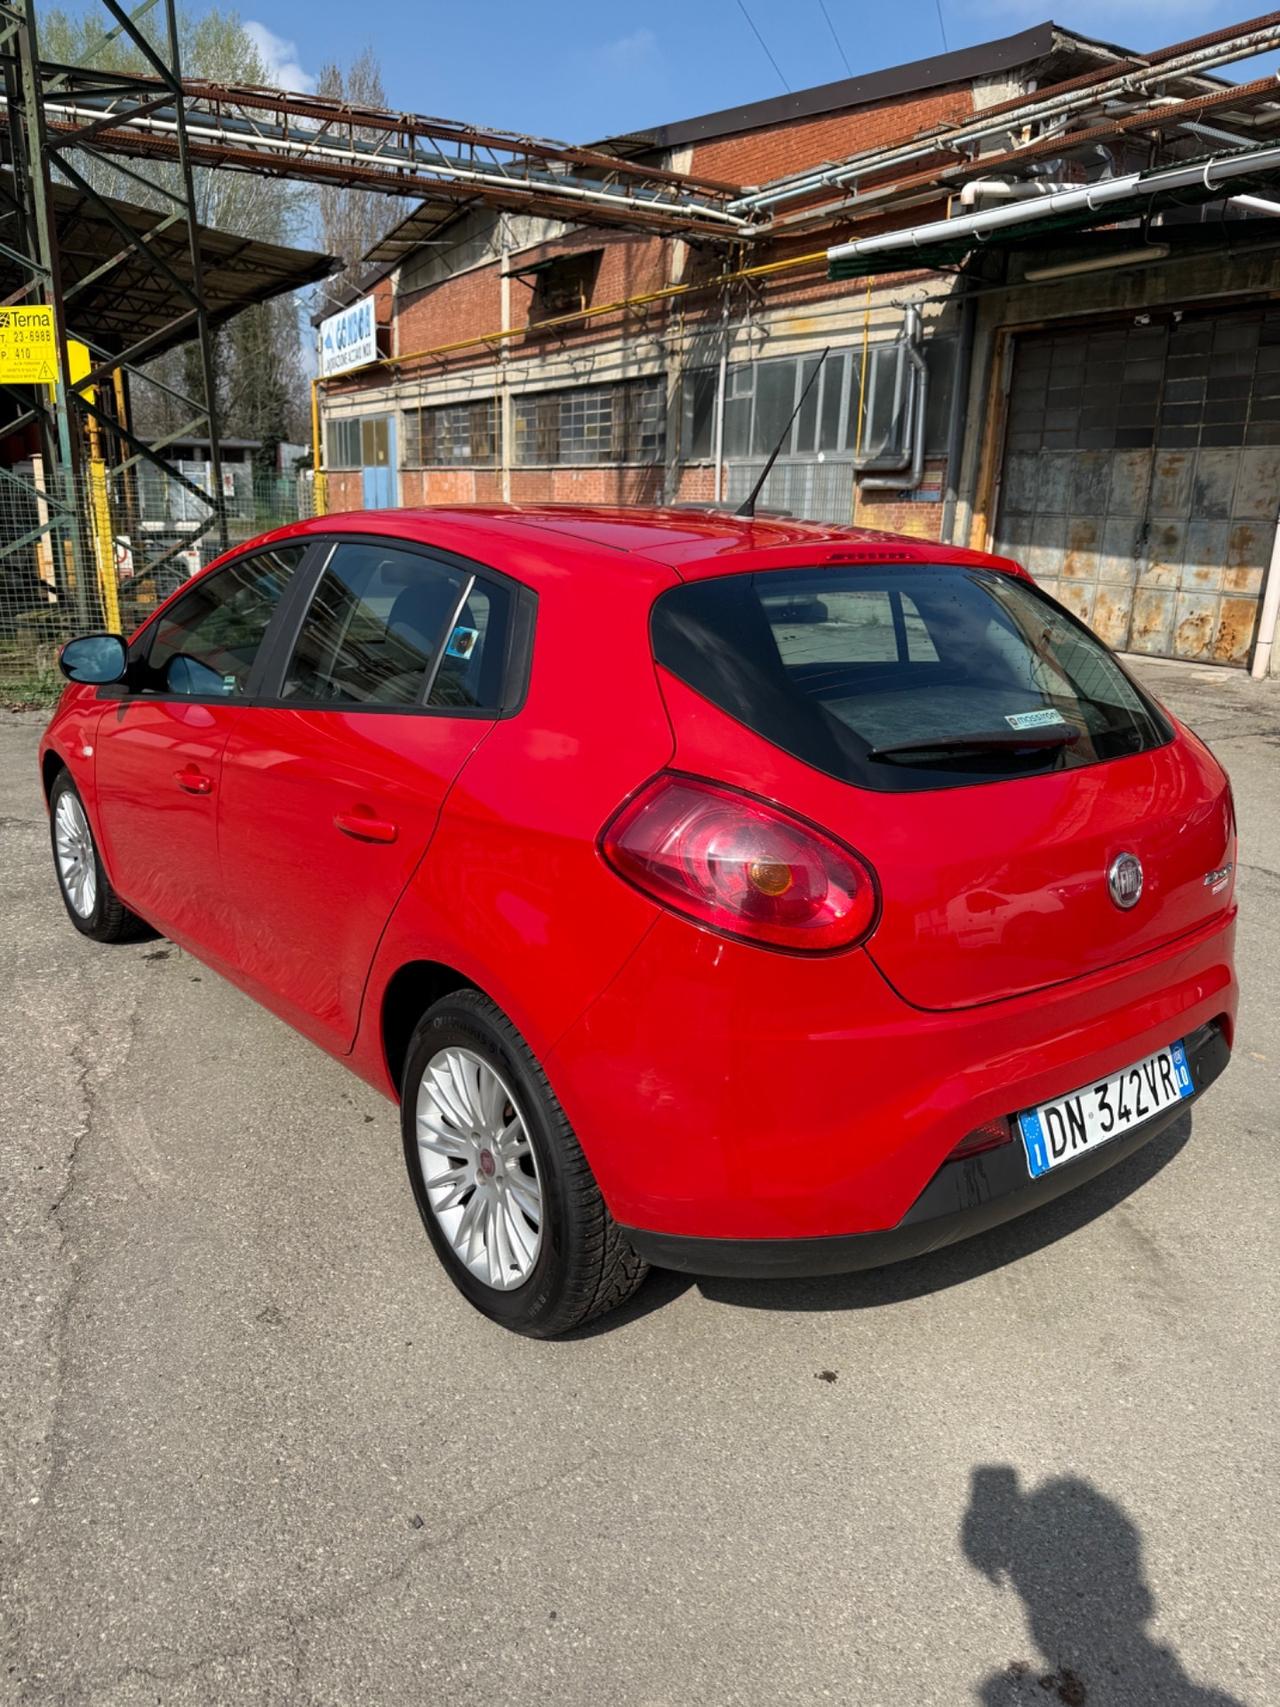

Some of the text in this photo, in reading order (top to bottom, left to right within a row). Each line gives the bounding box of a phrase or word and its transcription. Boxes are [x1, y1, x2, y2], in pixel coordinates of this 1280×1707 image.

[11, 312, 50, 327] Terna
[16, 348, 31, 359] 410
[1044, 1096, 1088, 1158] DN
[1094, 1053, 1177, 1133] 342VR
